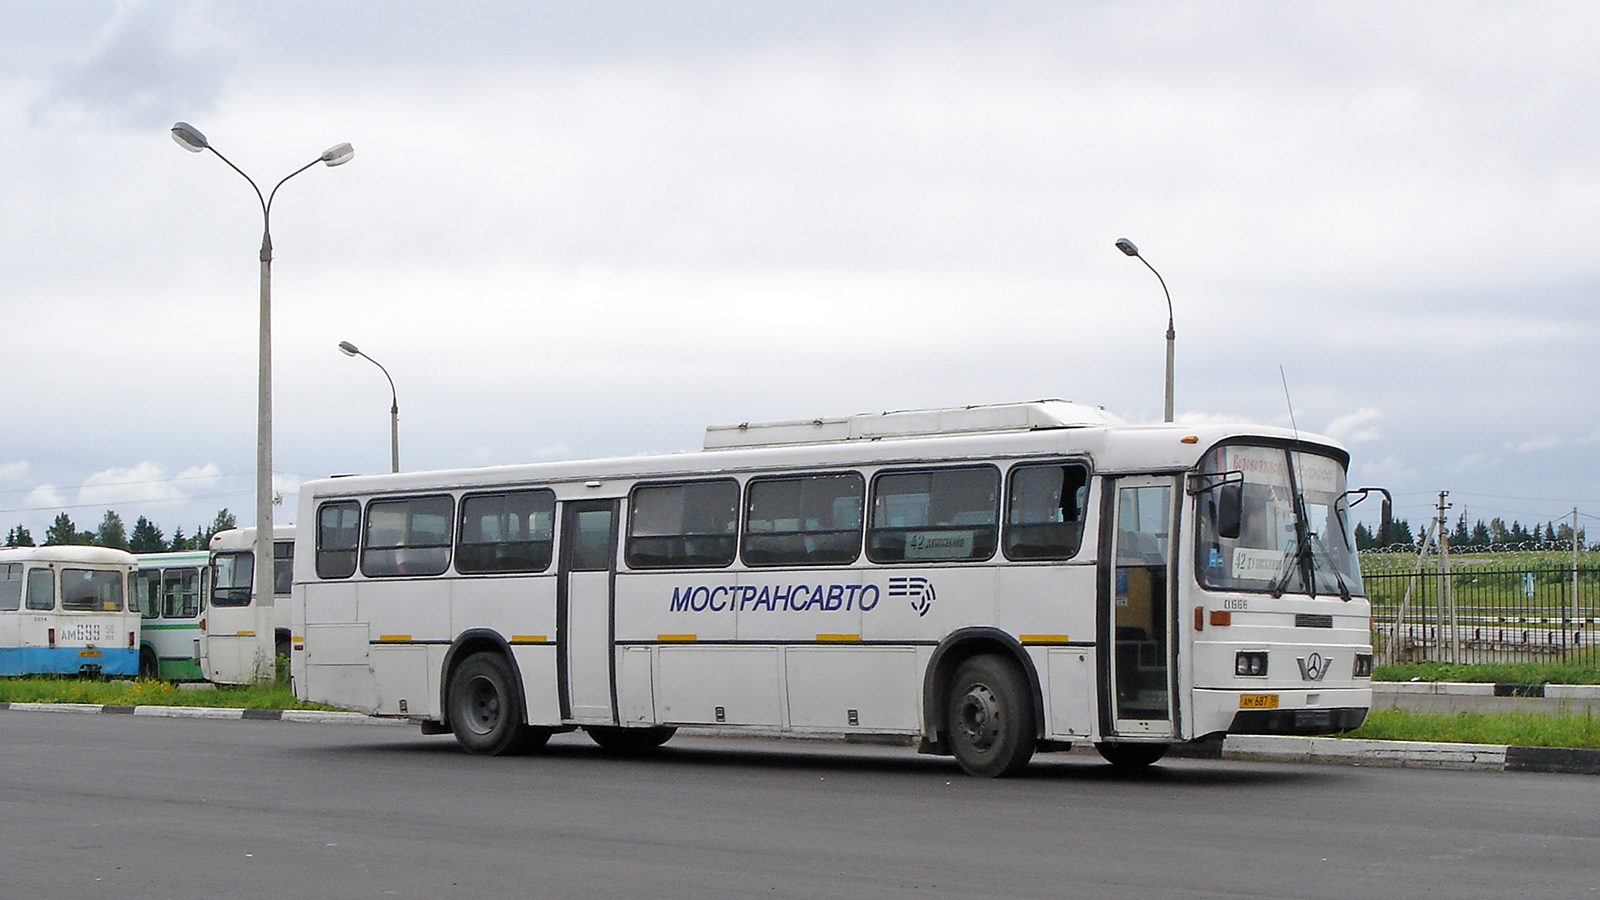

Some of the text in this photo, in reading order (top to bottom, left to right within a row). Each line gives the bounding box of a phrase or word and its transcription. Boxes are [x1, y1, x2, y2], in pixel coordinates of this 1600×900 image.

[910, 535, 925, 550] 42
[1235, 552, 1246, 570] 42
[669, 584, 880, 612] МОСТРАНСАВТО
[1255, 696, 1268, 706] 687
